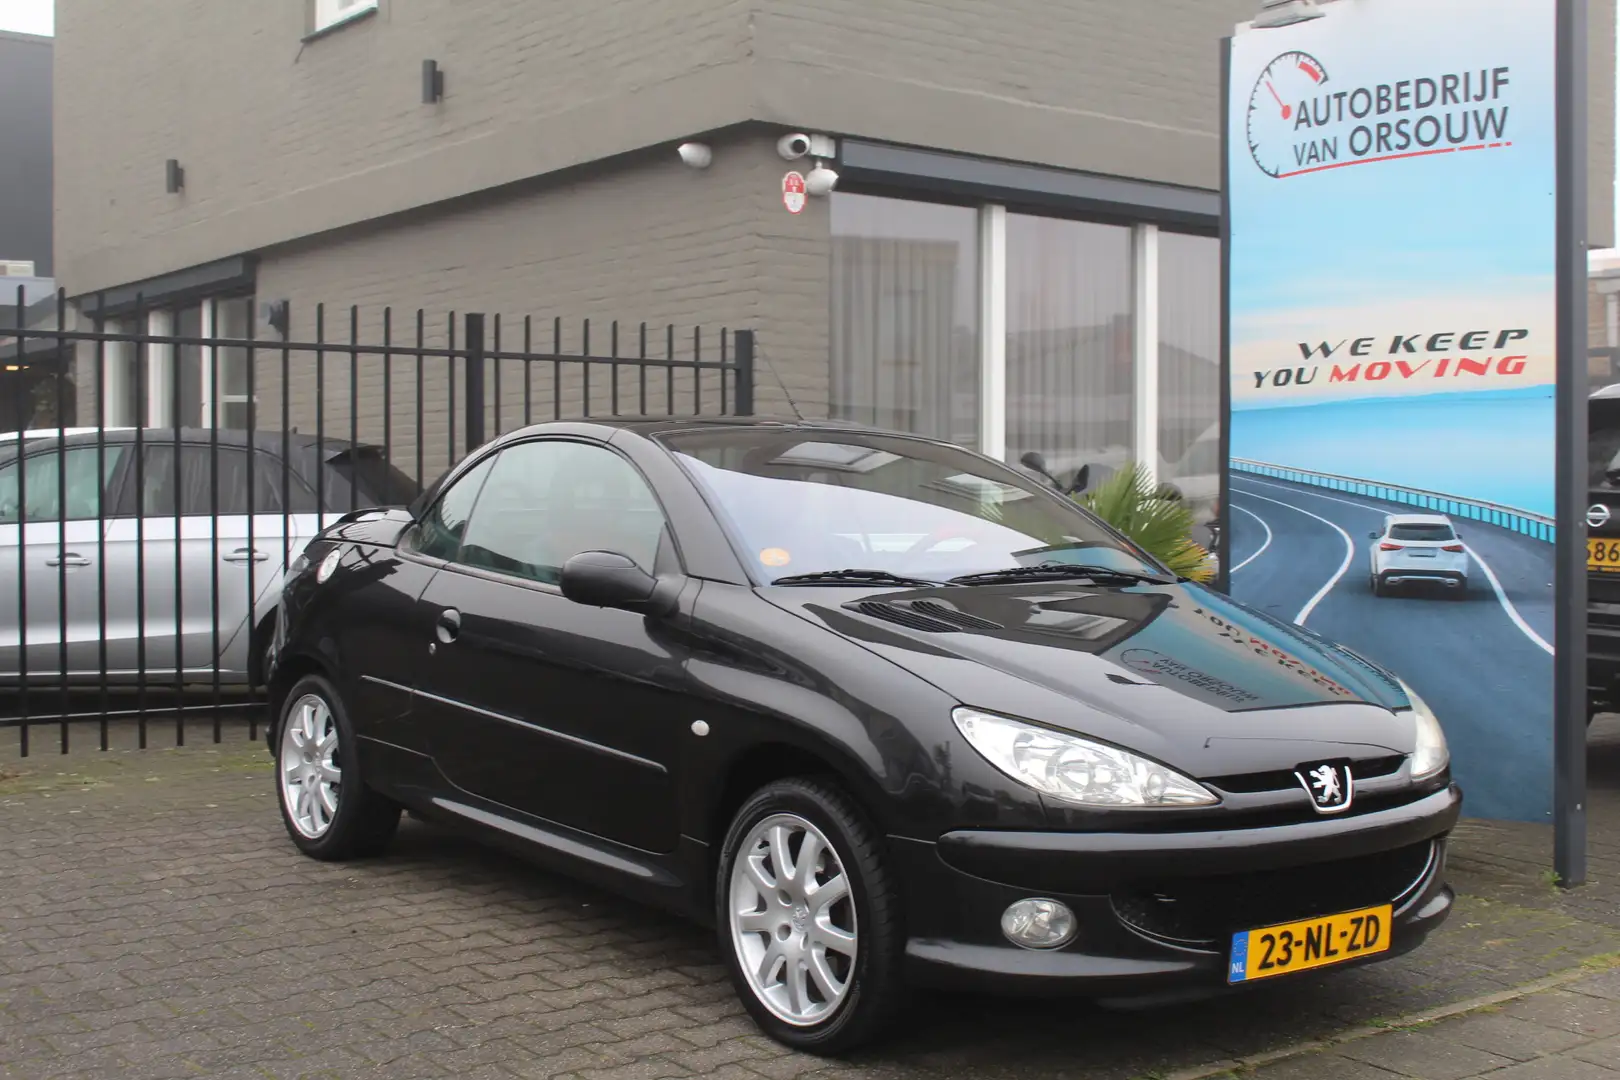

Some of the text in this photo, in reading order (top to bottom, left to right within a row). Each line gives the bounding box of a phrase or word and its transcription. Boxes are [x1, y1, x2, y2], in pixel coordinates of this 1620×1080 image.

[1294, 66, 1509, 131] AUTOBEDRIJF
[1293, 106, 1509, 166] VAN ORSOUW
[1298, 328, 1529, 360] WE KEEP
[1253, 355, 1528, 388] YOU MOVING
[1258, 914, 1380, 970] 23-NL-ZD
[1231, 962, 1245, 974] NL
